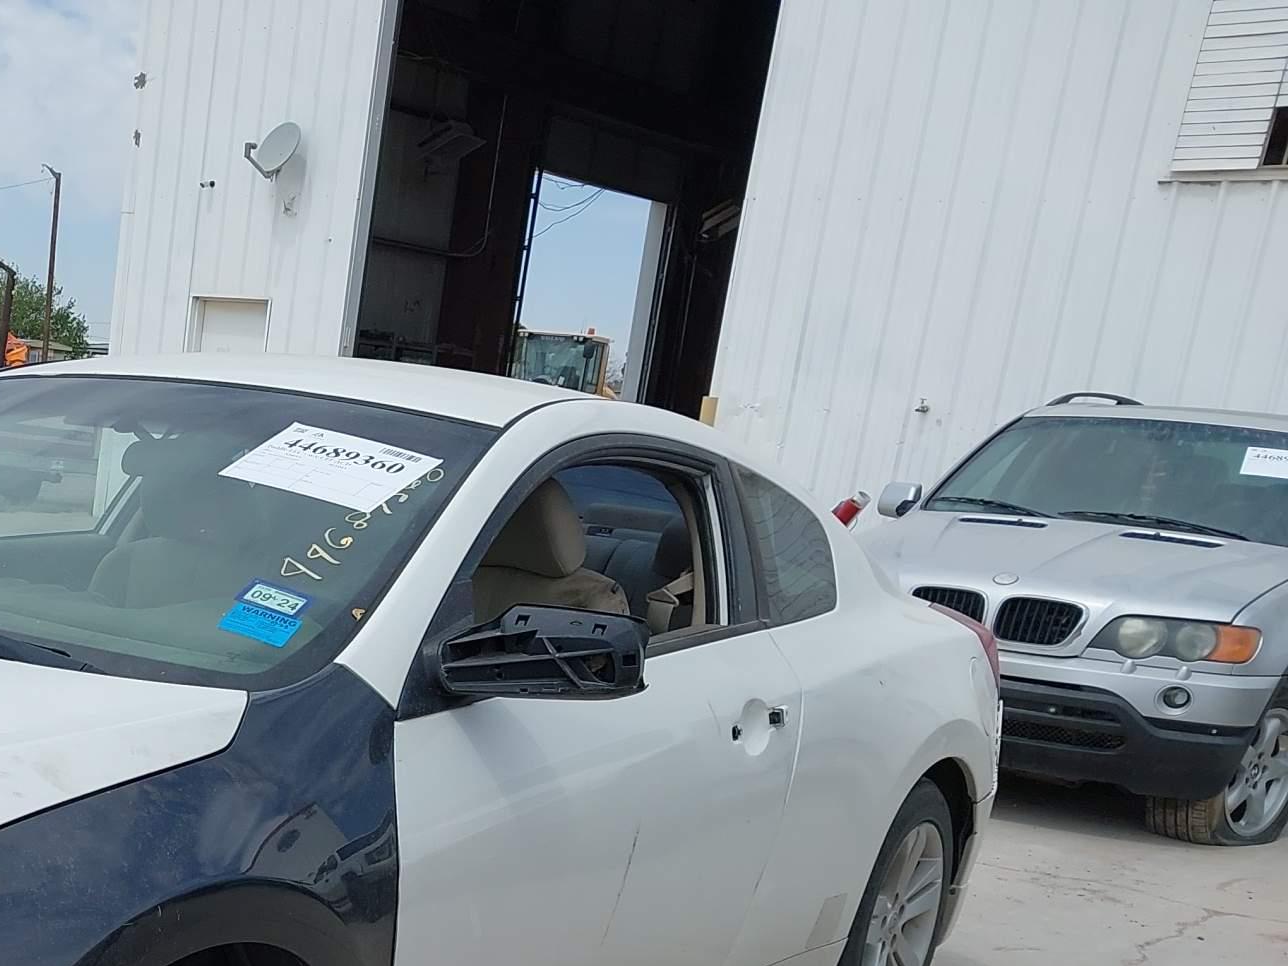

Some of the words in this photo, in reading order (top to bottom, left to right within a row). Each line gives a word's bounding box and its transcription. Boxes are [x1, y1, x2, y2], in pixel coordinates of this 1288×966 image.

[283, 438, 406, 474] 44689360
[251, 590, 272, 602] 09
[277, 599, 299, 610] 24
[242, 606, 297, 627] WARNING
